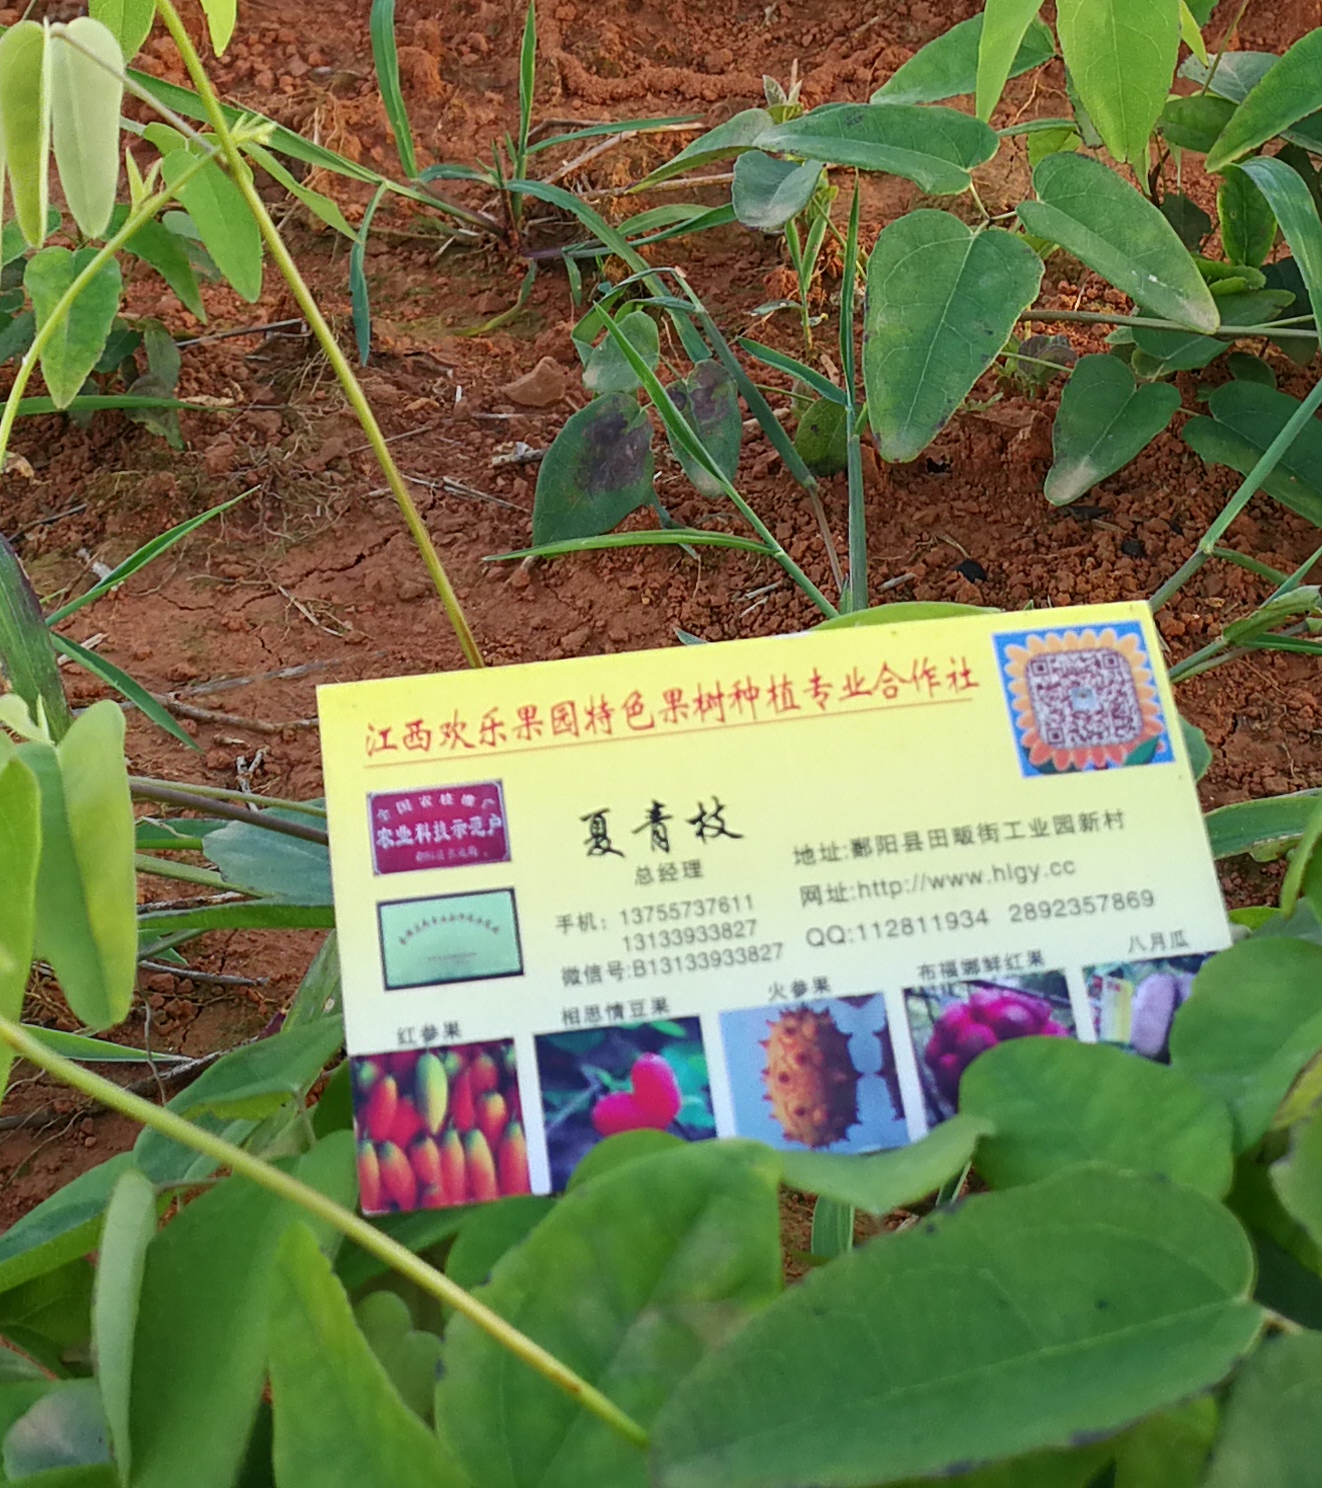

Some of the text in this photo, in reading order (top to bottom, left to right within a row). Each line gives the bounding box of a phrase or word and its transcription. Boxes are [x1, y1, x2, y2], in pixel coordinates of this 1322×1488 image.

[365, 656, 979, 756] 江西欢乐果园特色果树种植专业合作社
[579, 795, 744, 858] 夏青枝
[635, 859, 704, 886] 总经理
[1008, 889, 1155, 924] 2892357869
[623, 919, 758, 952] 13133933827
[1127, 930, 1189, 953] 八月瓜
[768, 975, 832, 1002] 火参果
[562, 997, 670, 1026] 相思情豆果
[397, 1020, 462, 1045] 红参果
